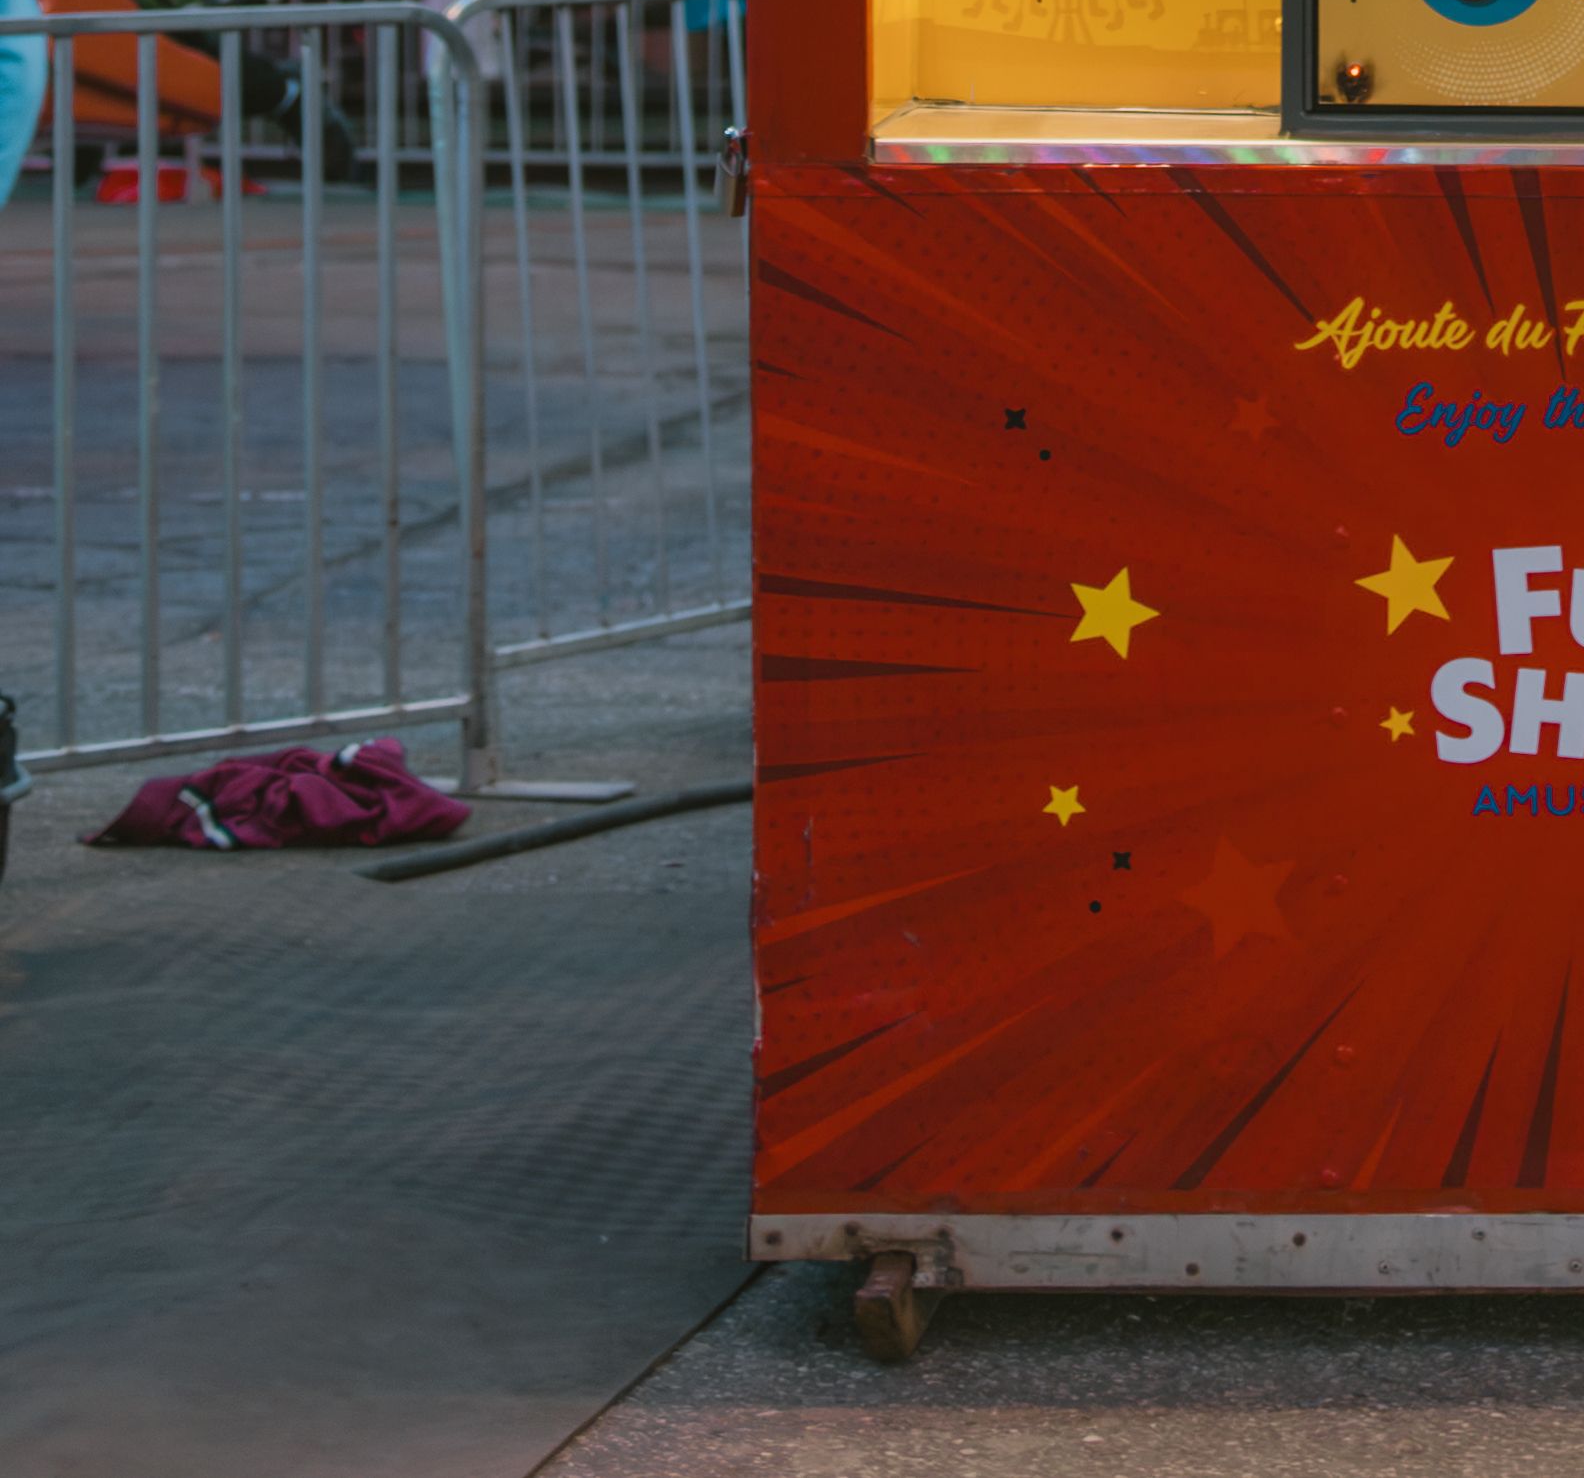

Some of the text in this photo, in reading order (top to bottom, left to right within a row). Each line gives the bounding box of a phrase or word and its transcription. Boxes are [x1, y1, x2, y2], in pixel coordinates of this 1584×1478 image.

[1295, 296, 1474, 370] Ajoute
[1485, 304, 1553, 353] du
[1395, 381, 1527, 448] Enjoy
